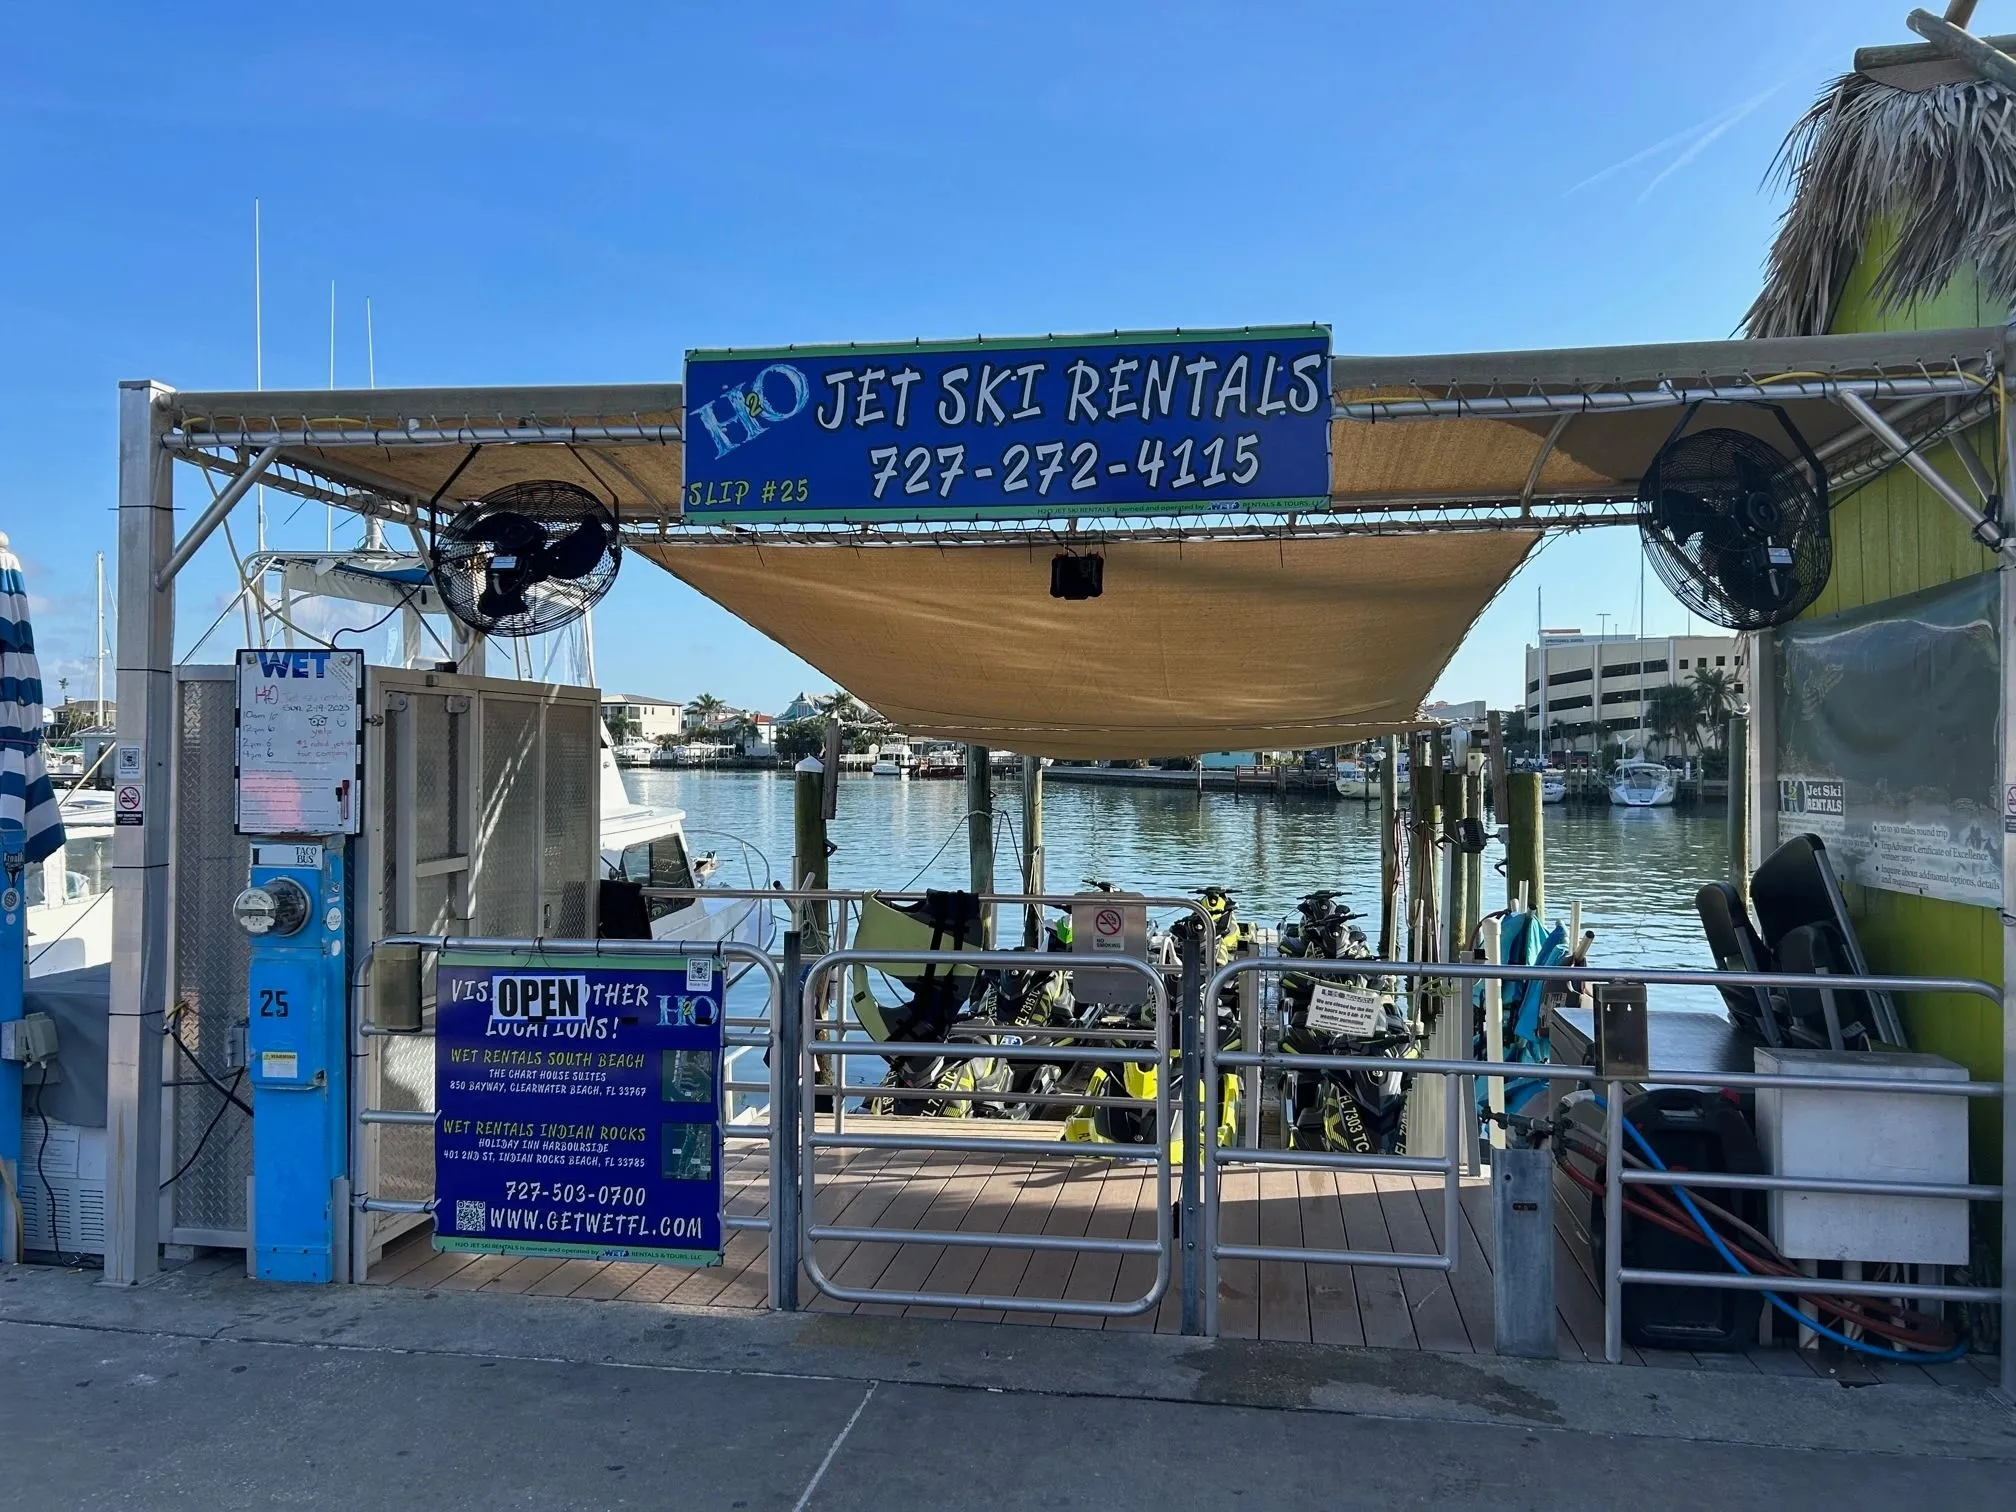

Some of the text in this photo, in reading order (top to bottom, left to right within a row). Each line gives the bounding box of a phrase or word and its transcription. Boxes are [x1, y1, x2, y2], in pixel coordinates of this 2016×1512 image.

[817, 354, 1321, 429] JET SKI RENTALS
[870, 434, 1259, 498] 727-272-4115
[688, 478, 808, 506] SLIP #25
[258, 652, 331, 678] WET
[1807, 784, 1842, 797] Jet Ski
[1808, 798, 1842, 812] RENTALS
[1916, 828, 1934, 836] round
[1936, 829, 1948, 840] trip
[295, 846, 316, 855] TACO
[1914, 844, 1944, 856] Certificate
[1953, 848, 1988, 861] Excellence
[297, 855, 314, 864] BUS
[1902, 868, 1918, 878] about
[1918, 870, 1949, 882] additional
[1950, 875, 1976, 886] options,
[1976, 878, 2000, 890] details
[260, 990, 289, 1018] 25
[499, 978, 580, 1018] OPEN
[1020, 997, 1036, 1014] 7315
[1333, 1001, 1350, 1010] closed
[1324, 1006, 1338, 1014] hours
[1014, 1016, 1030, 1026] FL
[450, 1048, 645, 1068] WET RENTALS SOUTH BEACH
[489, 1068, 606, 1082] THE CHART HOUSE SUITES
[940, 1072, 958, 1085] TC
[450, 1080, 646, 1097] 850 BAYWAY, CLEARWATER BEACH, FL 33767
[444, 1119, 646, 1142] WET RENTALS INDIAN ROCKS
[1339, 1095, 1370, 1152] FL 7303 TC
[478, 1138, 609, 1152] HOLIDAY INN HARBOURSIDE
[444, 1150, 645, 1168] 401 2ND ST, INDIAN ROCKS BEACH, FL 33785
[506, 1181, 646, 1206] 727-503-0700
[490, 1208, 702, 1239] WWW.GETWETFL.COM
